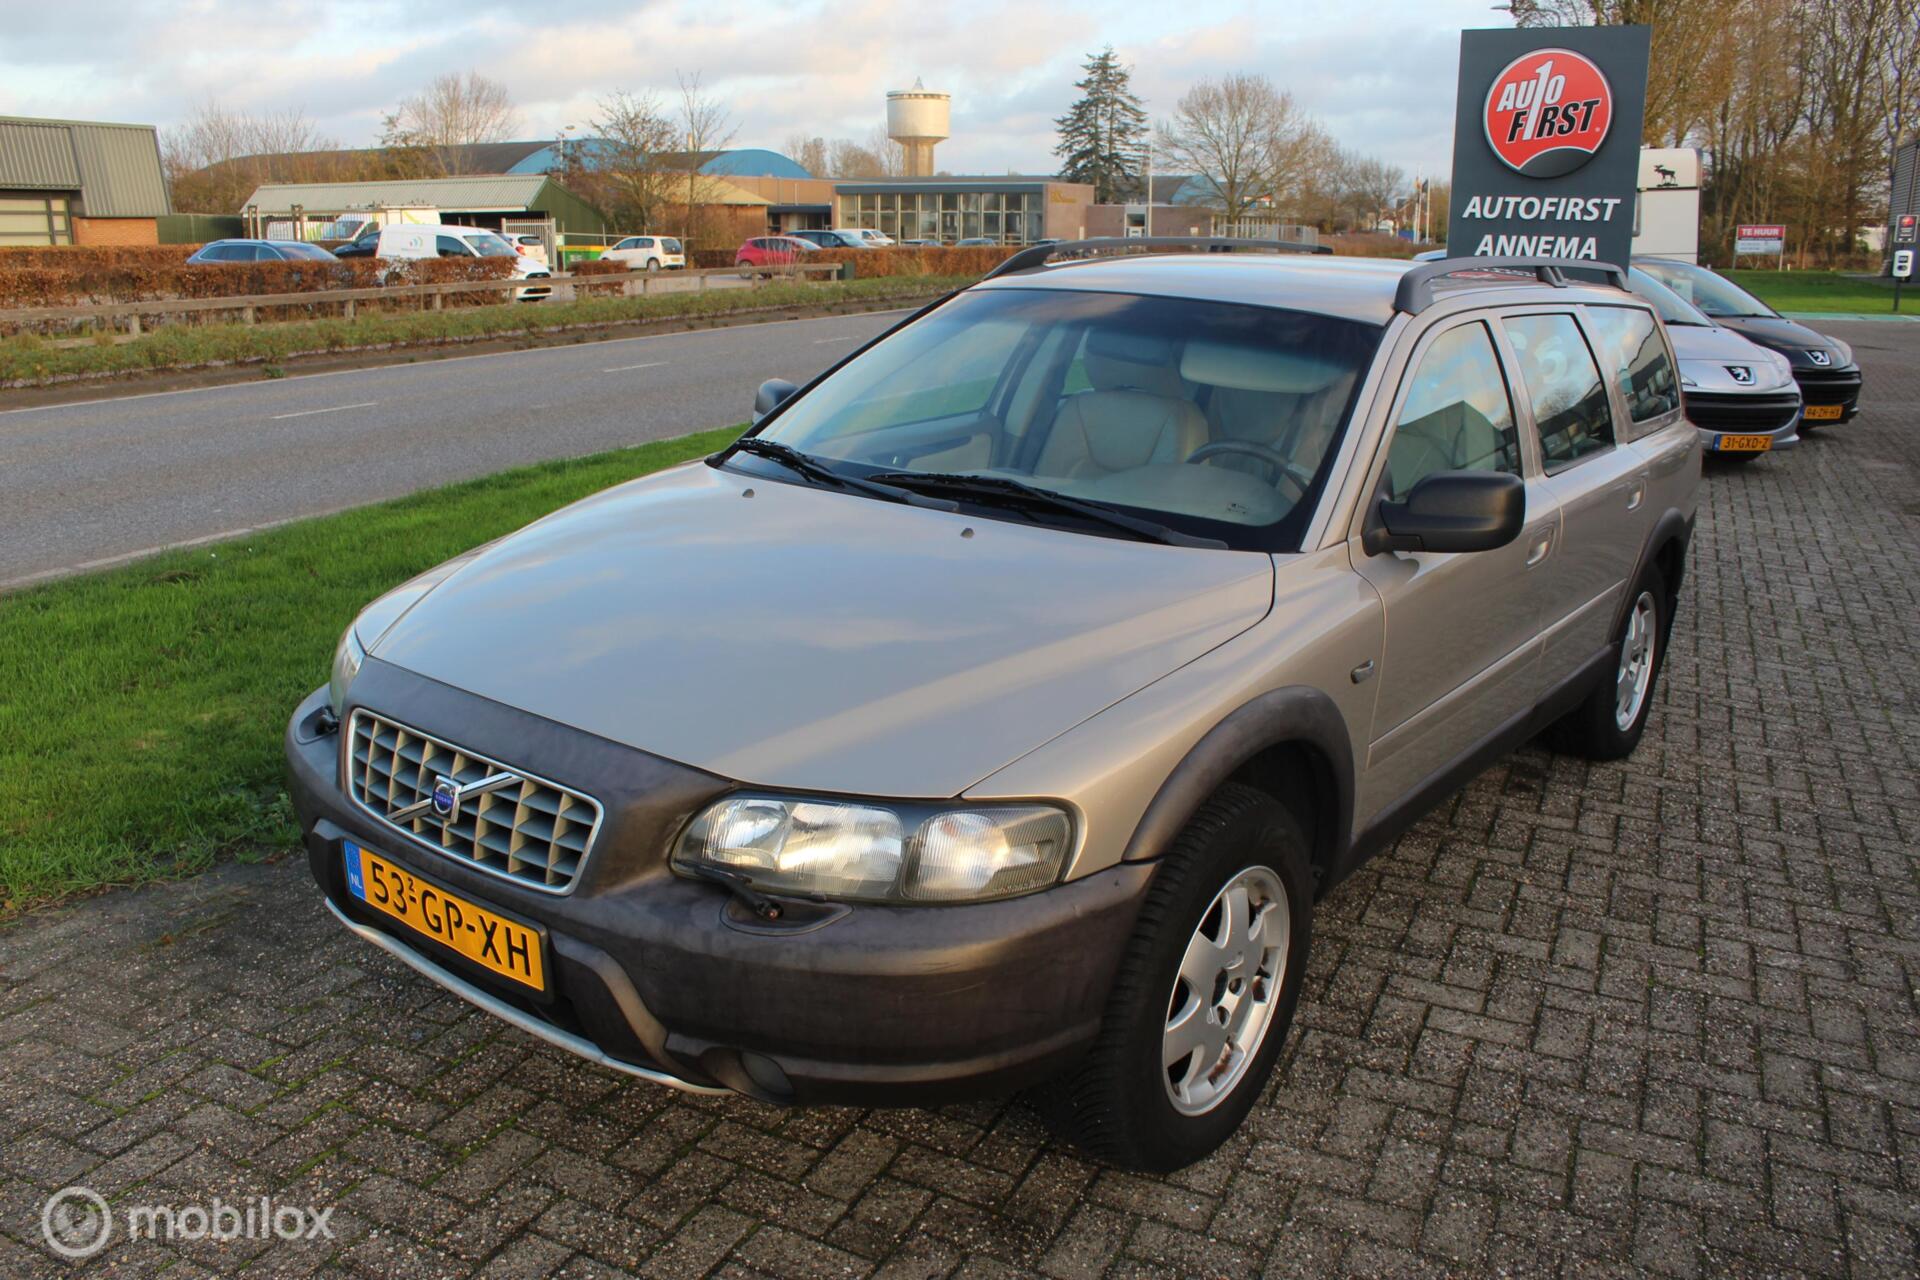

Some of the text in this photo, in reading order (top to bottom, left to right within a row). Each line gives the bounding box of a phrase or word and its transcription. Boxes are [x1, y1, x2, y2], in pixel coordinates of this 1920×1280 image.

[1462, 195, 1621, 222] AUTOFIRST
[1474, 234, 1597, 260] ANNEMA
[350, 872, 363, 889] NL
[371, 860, 532, 977] 53-GP-XH
